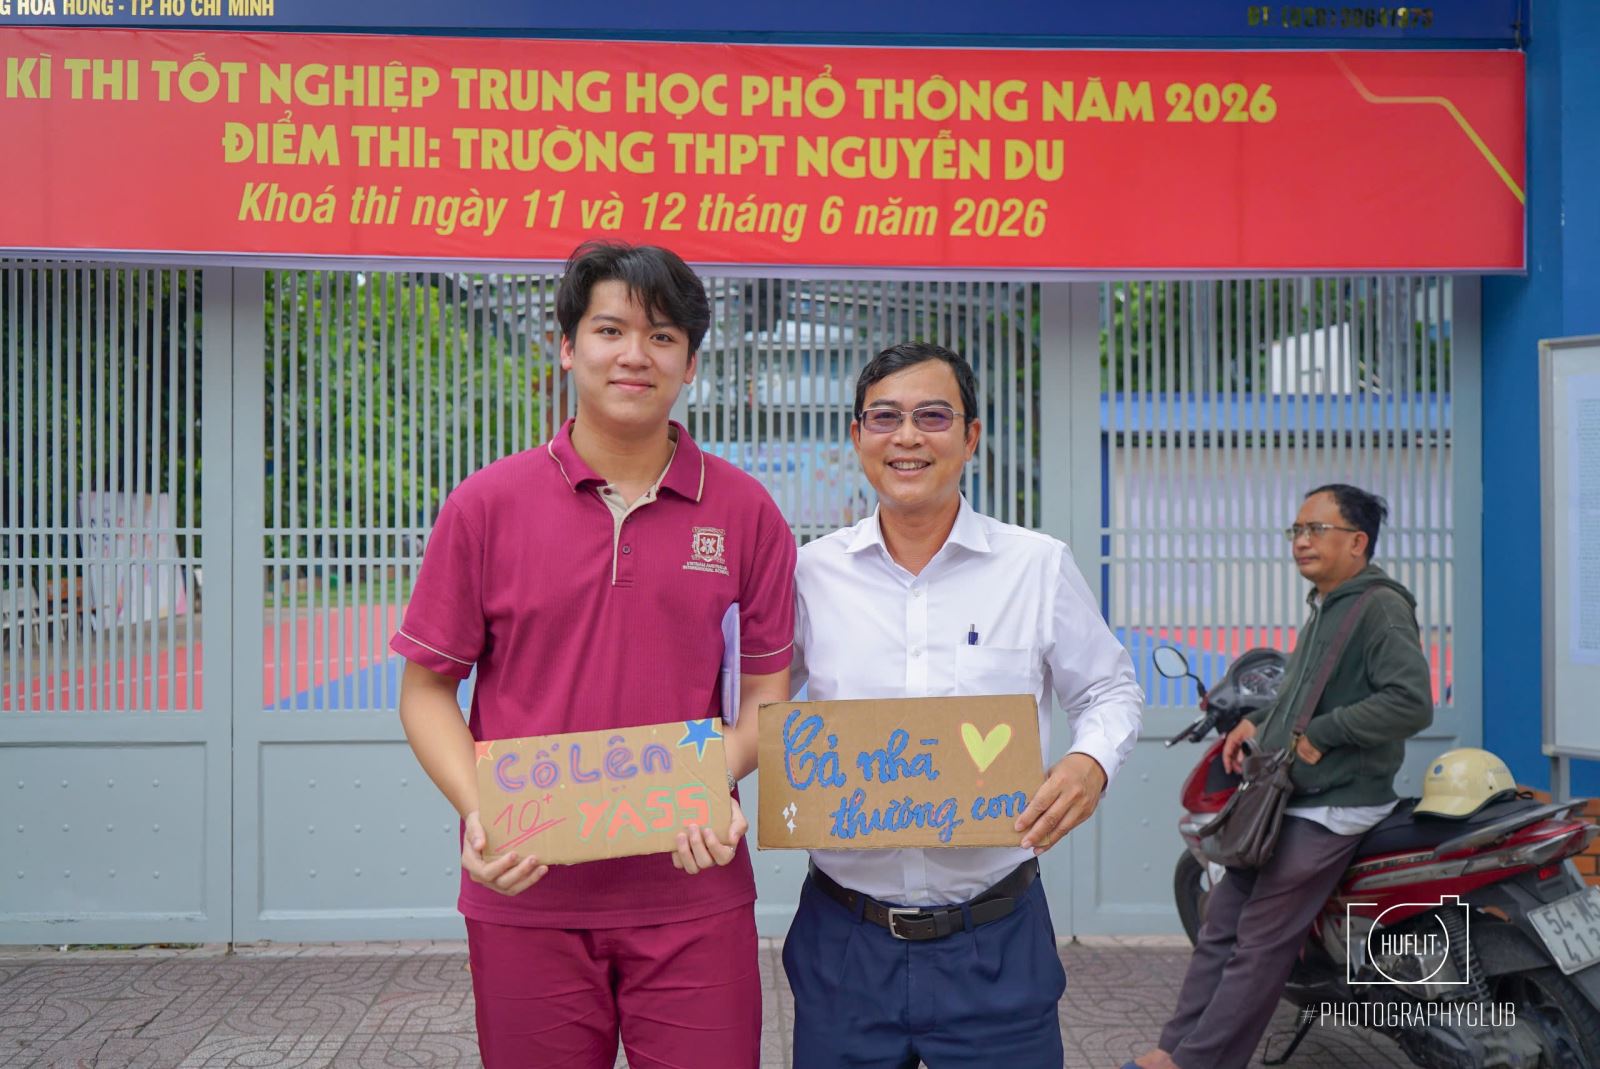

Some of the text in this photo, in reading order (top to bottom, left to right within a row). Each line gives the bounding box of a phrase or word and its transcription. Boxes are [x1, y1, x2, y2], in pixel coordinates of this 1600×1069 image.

[228, 0, 275, 16] MINH
[6, 51, 1277, 124] KÌ THI TỐT NGHIỆP TRUNG HỌC PHỔ THÔNG NĂM 2026
[221, 109, 1065, 183] ĐIỂM THI: TRƯỜNG THPT NGUYỄN DU
[238, 181, 1049, 243] Khoá thi ngày 11 và 12 tháng 6 năm 2026
